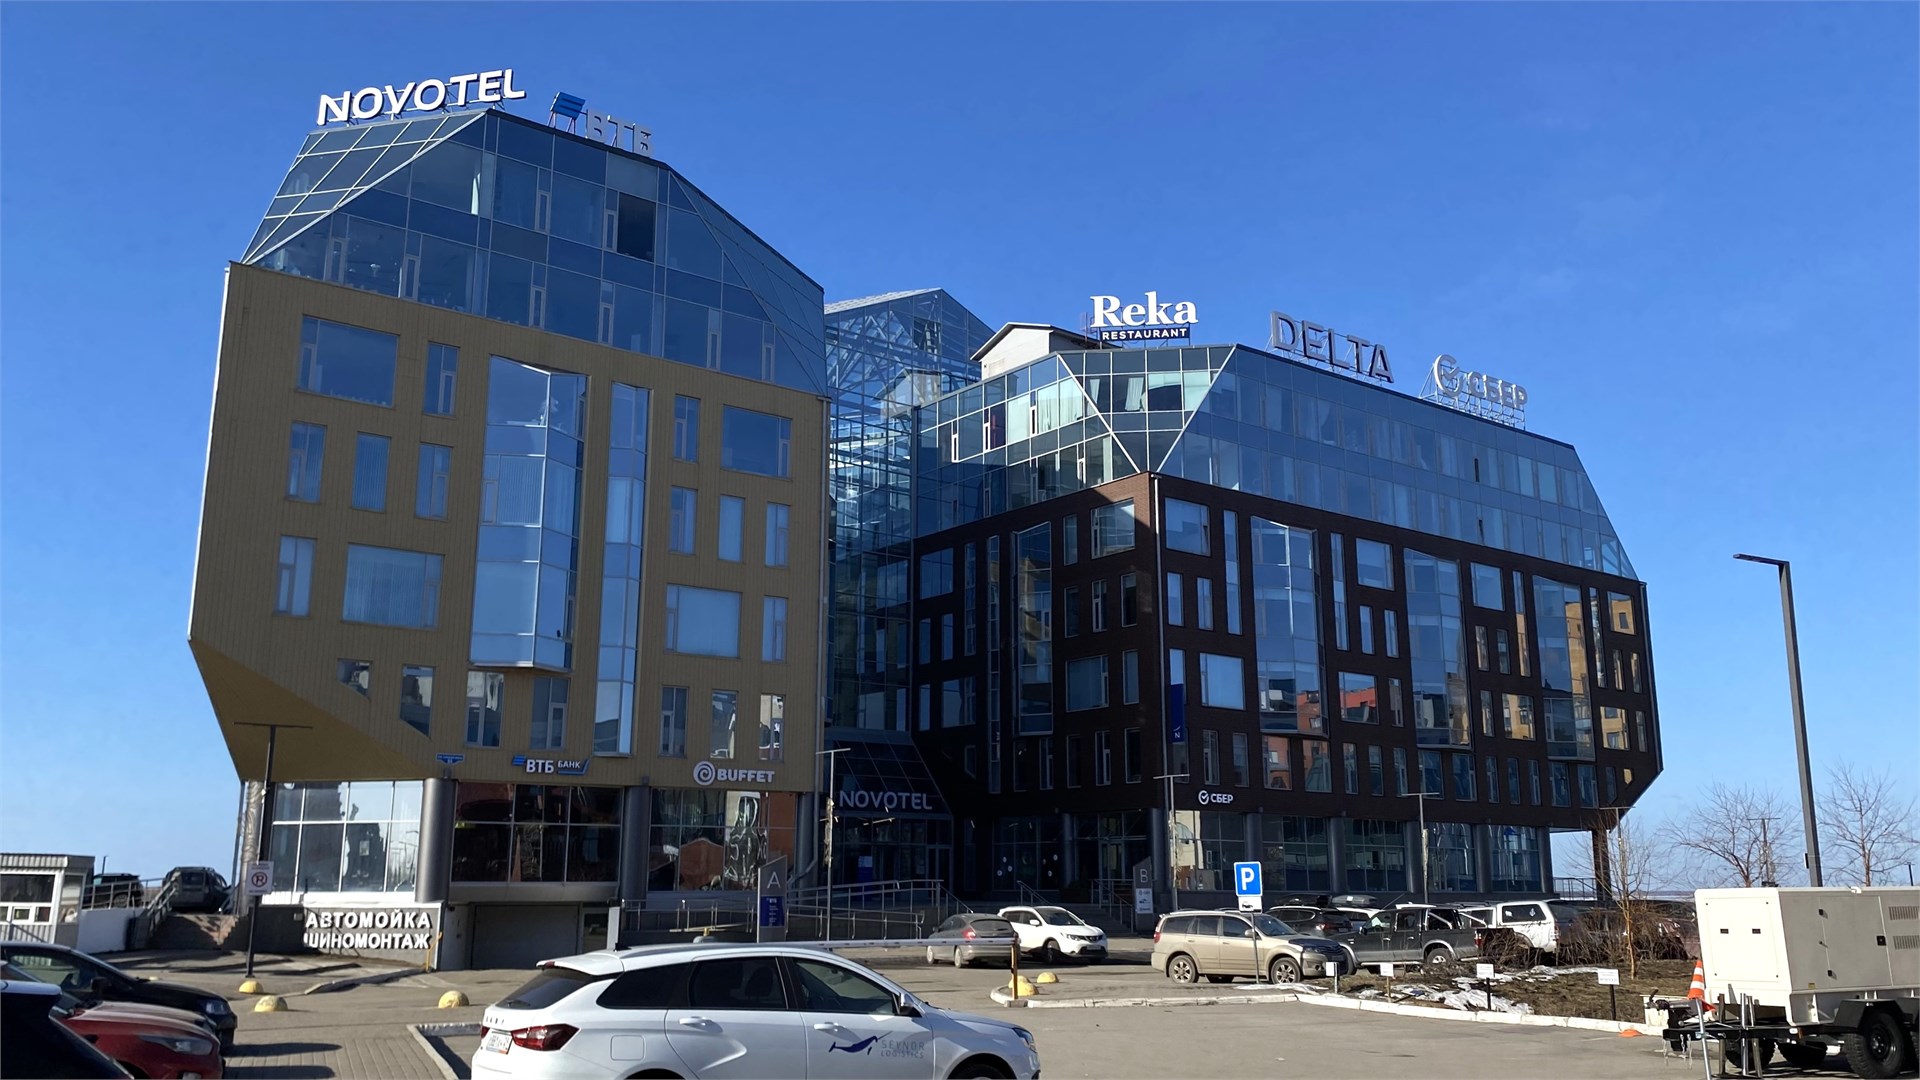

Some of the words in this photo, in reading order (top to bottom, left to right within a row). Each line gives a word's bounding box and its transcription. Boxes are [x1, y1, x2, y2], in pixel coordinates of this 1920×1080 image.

[317, 68, 526, 126] NOVOTEL
[586, 109, 655, 157] ВТБ
[1089, 290, 1199, 328] Reka
[1102, 328, 1187, 341] RESTAURANT
[1270, 310, 1395, 384] DELTA
[1467, 371, 1528, 409] СБЕР
[526, 759, 554, 774] ВТБ
[558, 760, 581, 769] БАНК
[717, 768, 775, 783] BUFFET
[839, 790, 933, 810] NOVOTEL
[1210, 793, 1234, 804] СБЕР
[766, 871, 781, 889] A
[1140, 868, 1149, 883] B
[1241, 867, 1255, 891] P
[305, 909, 432, 929] АВТОМОЙКА
[303, 932, 431, 949] ШИНОМОНТАЖ
[880, 1050, 925, 1059] LOGISTICS
